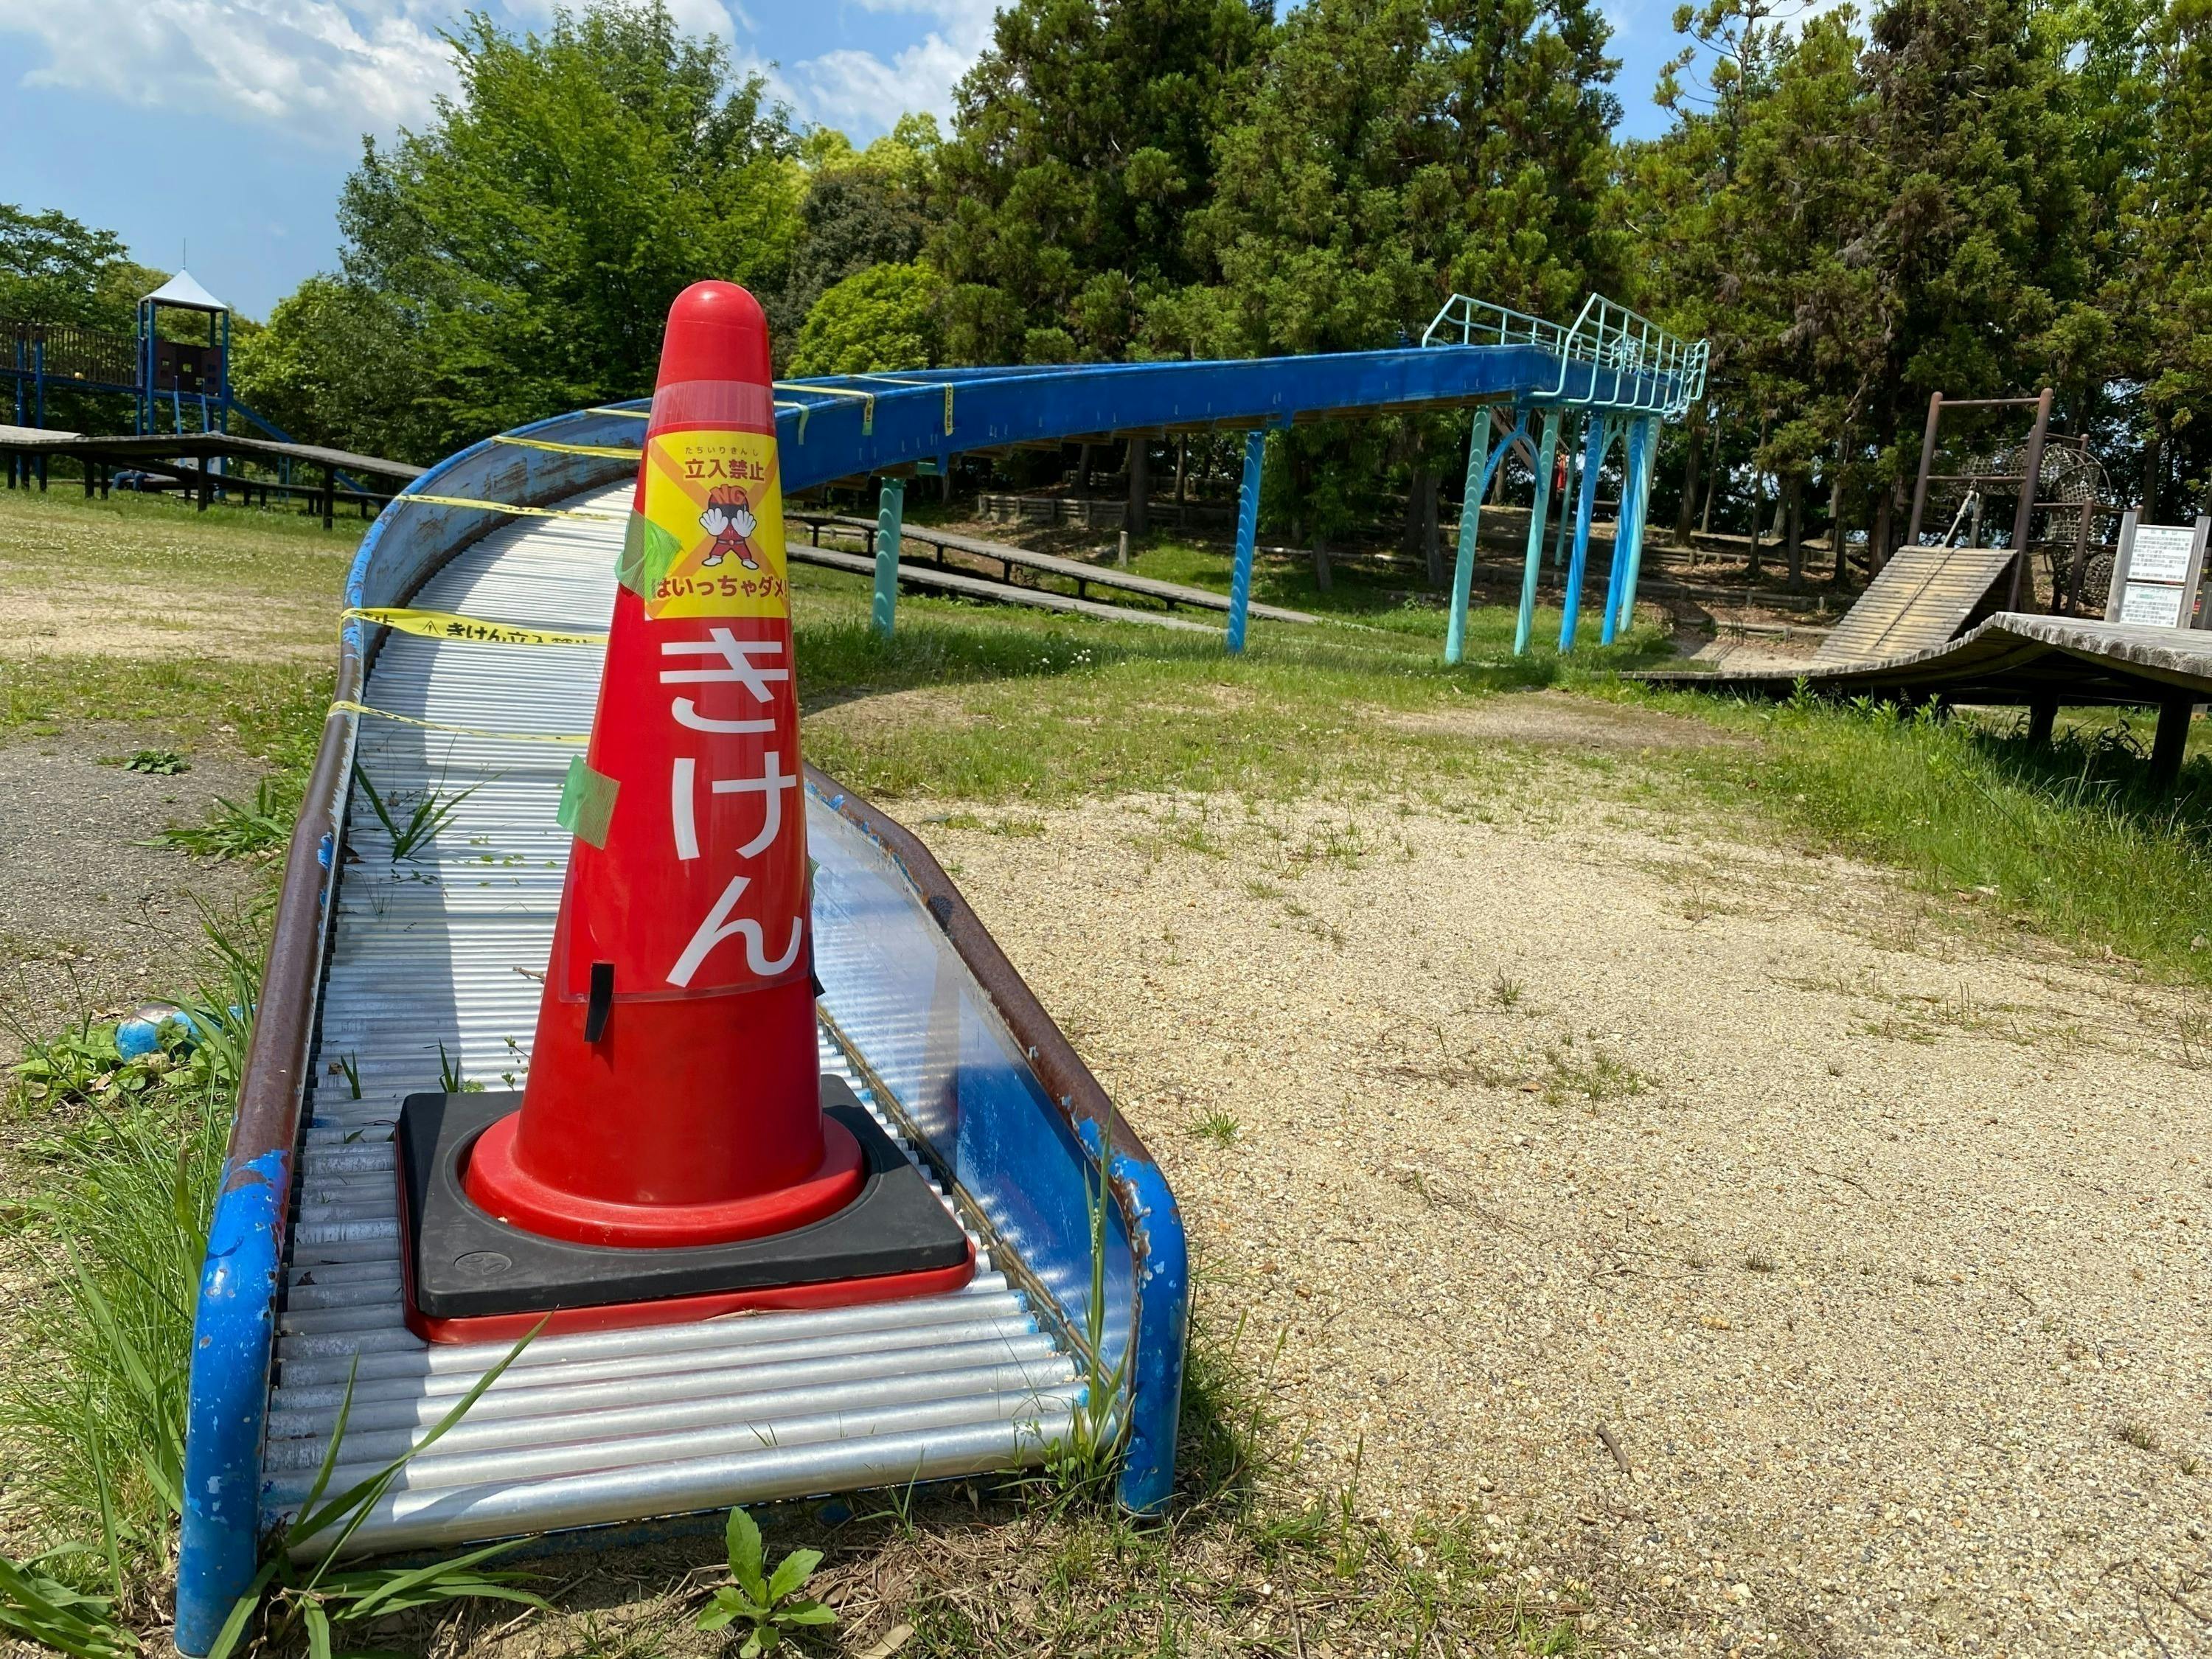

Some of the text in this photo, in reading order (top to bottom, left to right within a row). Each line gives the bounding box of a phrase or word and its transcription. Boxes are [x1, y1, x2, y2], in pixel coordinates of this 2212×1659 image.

[685, 447, 759, 456] たちいりきんし
[685, 458, 765, 481] 立入禁止
[709, 483, 748, 505] NG
[446, 622, 594, 644] きけん立入
[660, 627, 803, 988] きけん
